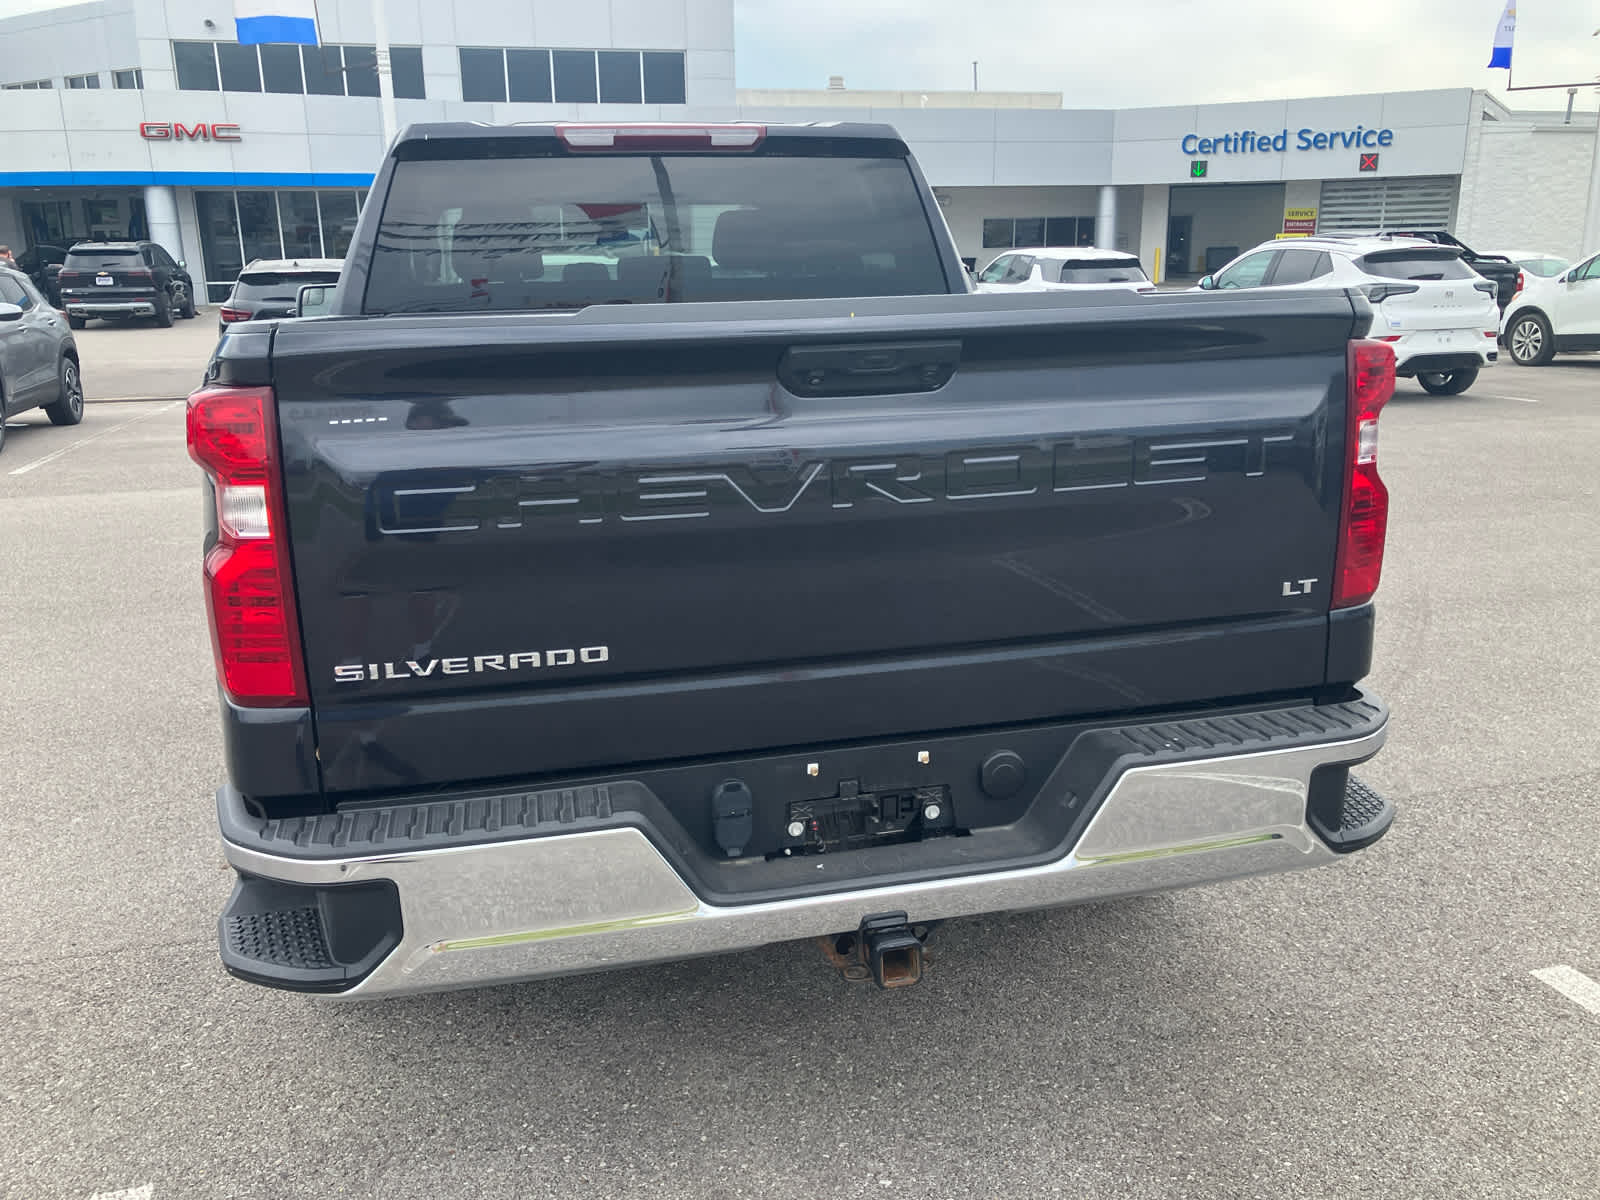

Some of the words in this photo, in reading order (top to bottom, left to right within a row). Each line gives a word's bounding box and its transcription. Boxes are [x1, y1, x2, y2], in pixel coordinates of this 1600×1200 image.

[140, 122, 240, 140] GMC
[1182, 130, 1287, 155] Certified
[1296, 125, 1393, 150] Service
[376, 434, 1296, 534] CHEVROLET
[1282, 578, 1318, 596] LT
[334, 646, 609, 682] SILVERADO
